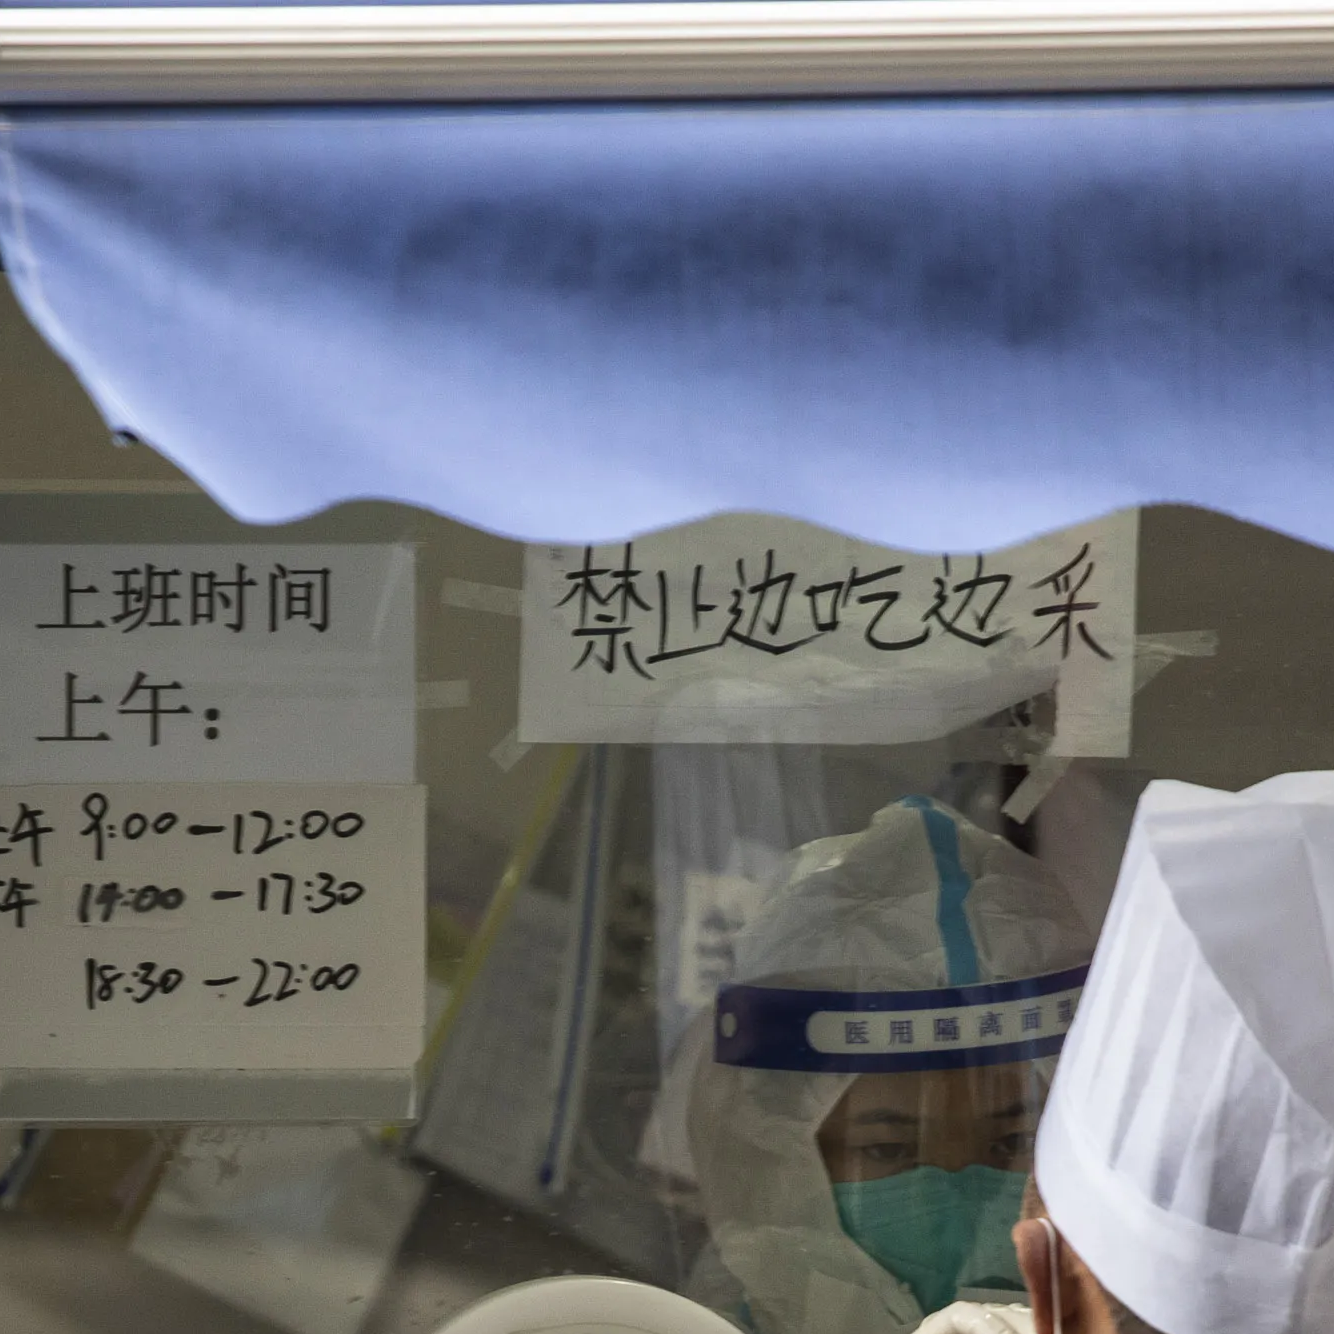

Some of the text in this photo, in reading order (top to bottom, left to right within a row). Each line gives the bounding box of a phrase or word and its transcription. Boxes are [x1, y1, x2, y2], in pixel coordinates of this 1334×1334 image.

[34, 563, 331, 633] 上班时间
[555, 540, 1114, 680] 禁止边吃边采
[34, 671, 221, 747] 上午：
